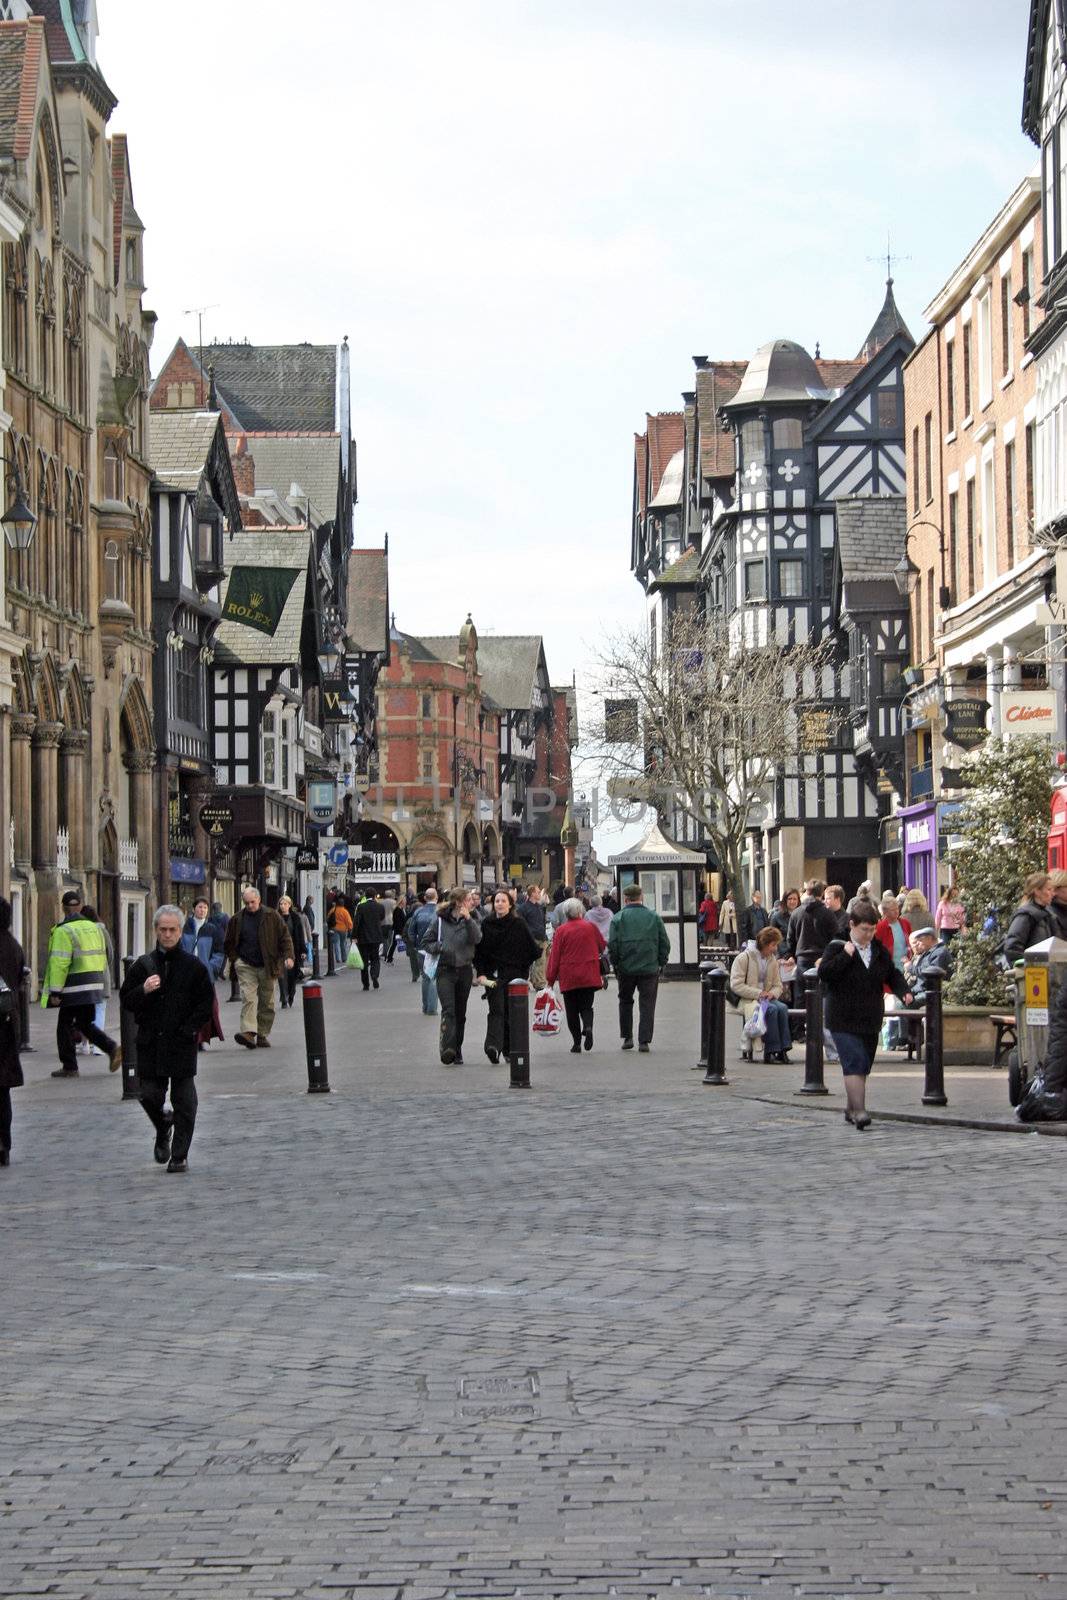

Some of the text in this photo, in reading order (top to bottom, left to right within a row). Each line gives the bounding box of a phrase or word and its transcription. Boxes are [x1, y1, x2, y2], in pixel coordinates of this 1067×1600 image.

[227, 603, 272, 627] ROLEX
[948, 702, 981, 711] GODSTALL
[533, 1002, 561, 1025] ale
